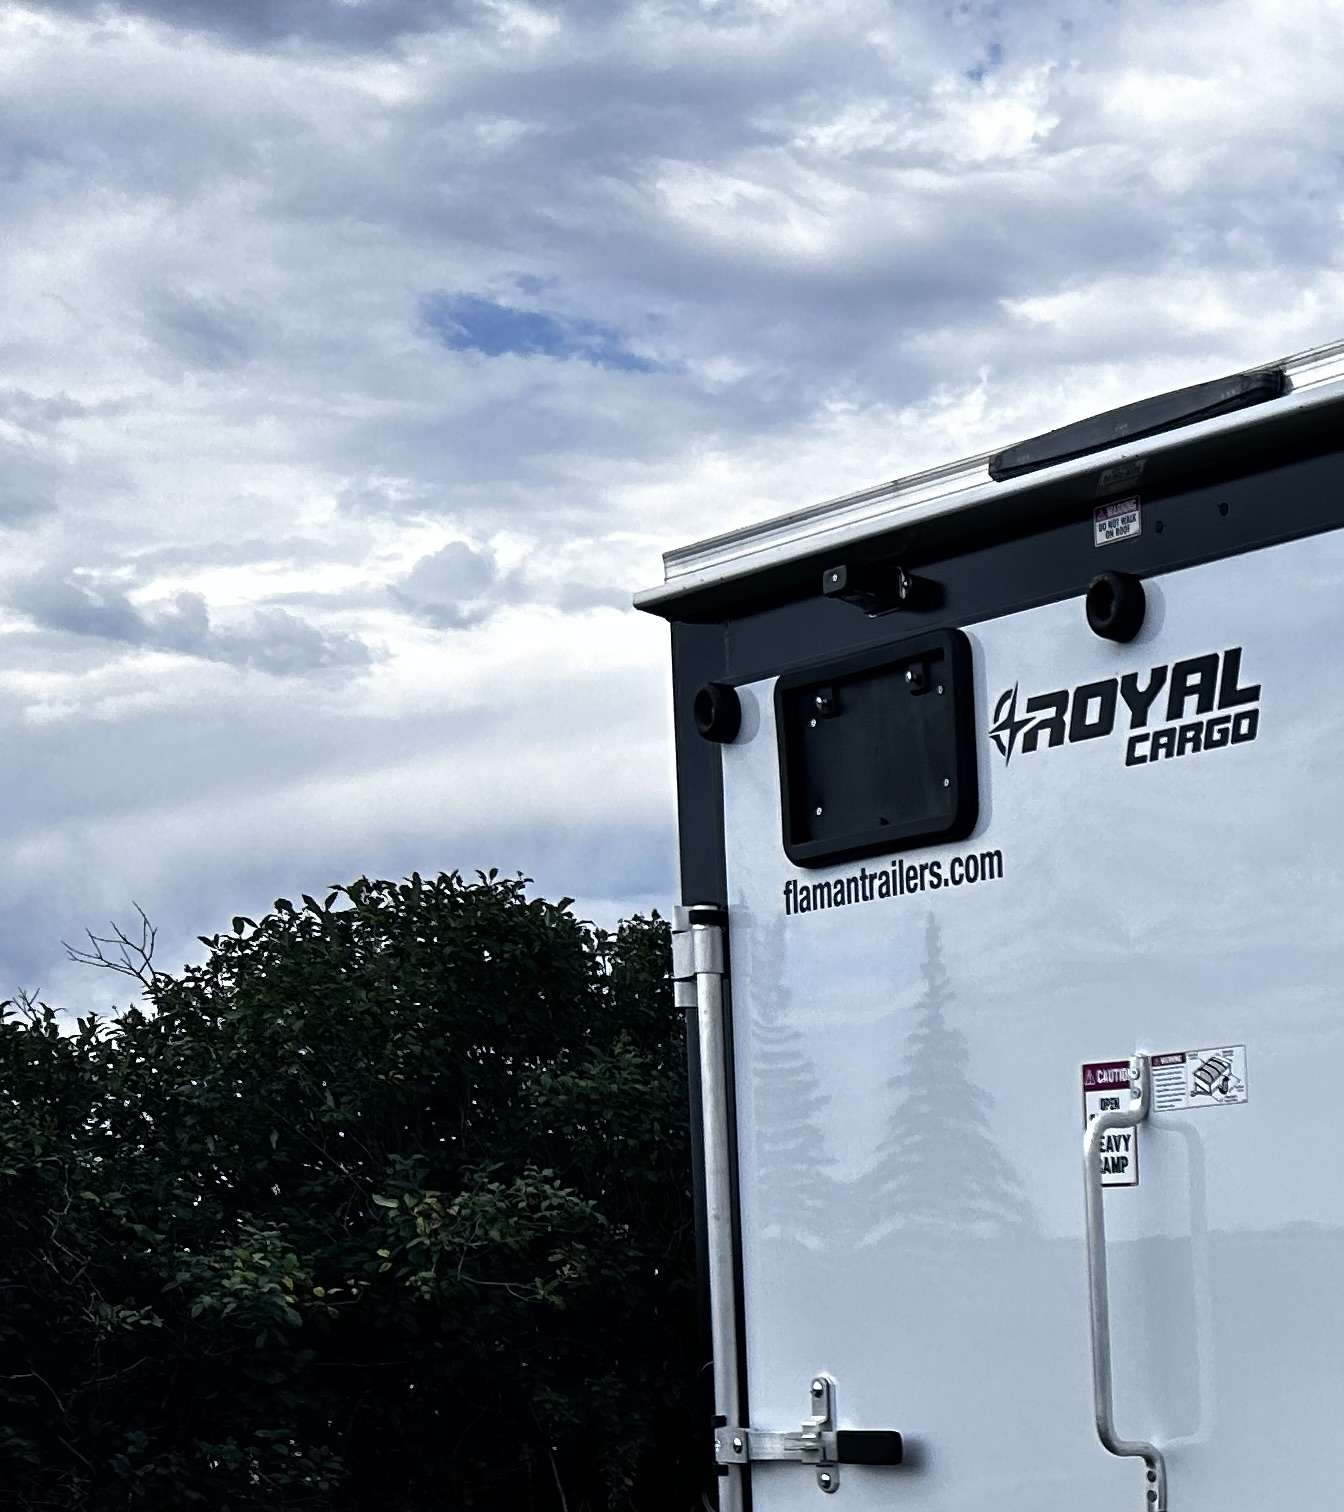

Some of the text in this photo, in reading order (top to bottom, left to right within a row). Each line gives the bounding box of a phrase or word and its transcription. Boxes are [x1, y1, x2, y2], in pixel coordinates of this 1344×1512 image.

[1021, 646, 1262, 754] ROYAL
[1125, 708, 1260, 767] CARGO
[783, 849, 1004, 916] flamantrailers.com
[1097, 1068, 1130, 1083] CAUTIO
[1099, 1134, 1132, 1153] EAVY
[1099, 1156, 1129, 1174] AMP
